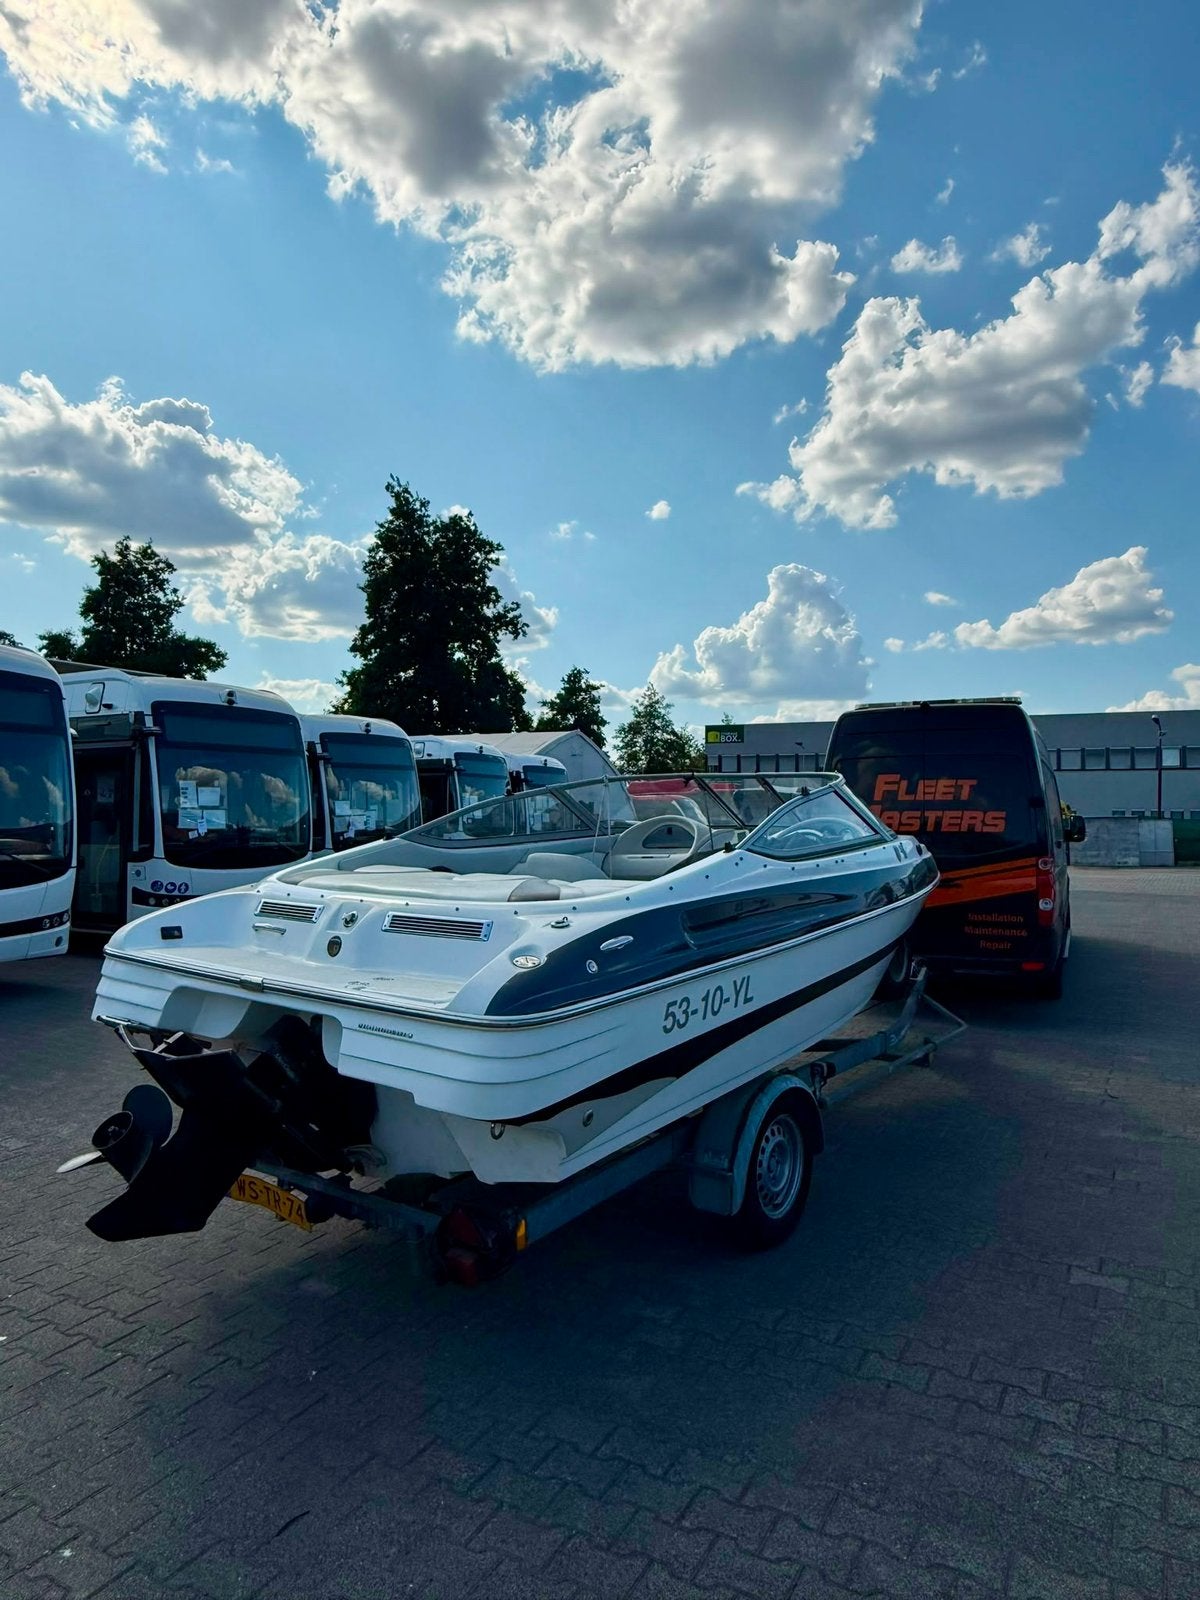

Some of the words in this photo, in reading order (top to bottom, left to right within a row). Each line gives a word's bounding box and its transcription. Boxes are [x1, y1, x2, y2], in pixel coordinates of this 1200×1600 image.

[873, 774, 977, 801] FLEET
[967, 913, 1024, 923] Installation
[964, 926, 1028, 936] Maintenance
[980, 940, 1012, 950] Repair
[662, 975, 754, 1034] 53-10-YL
